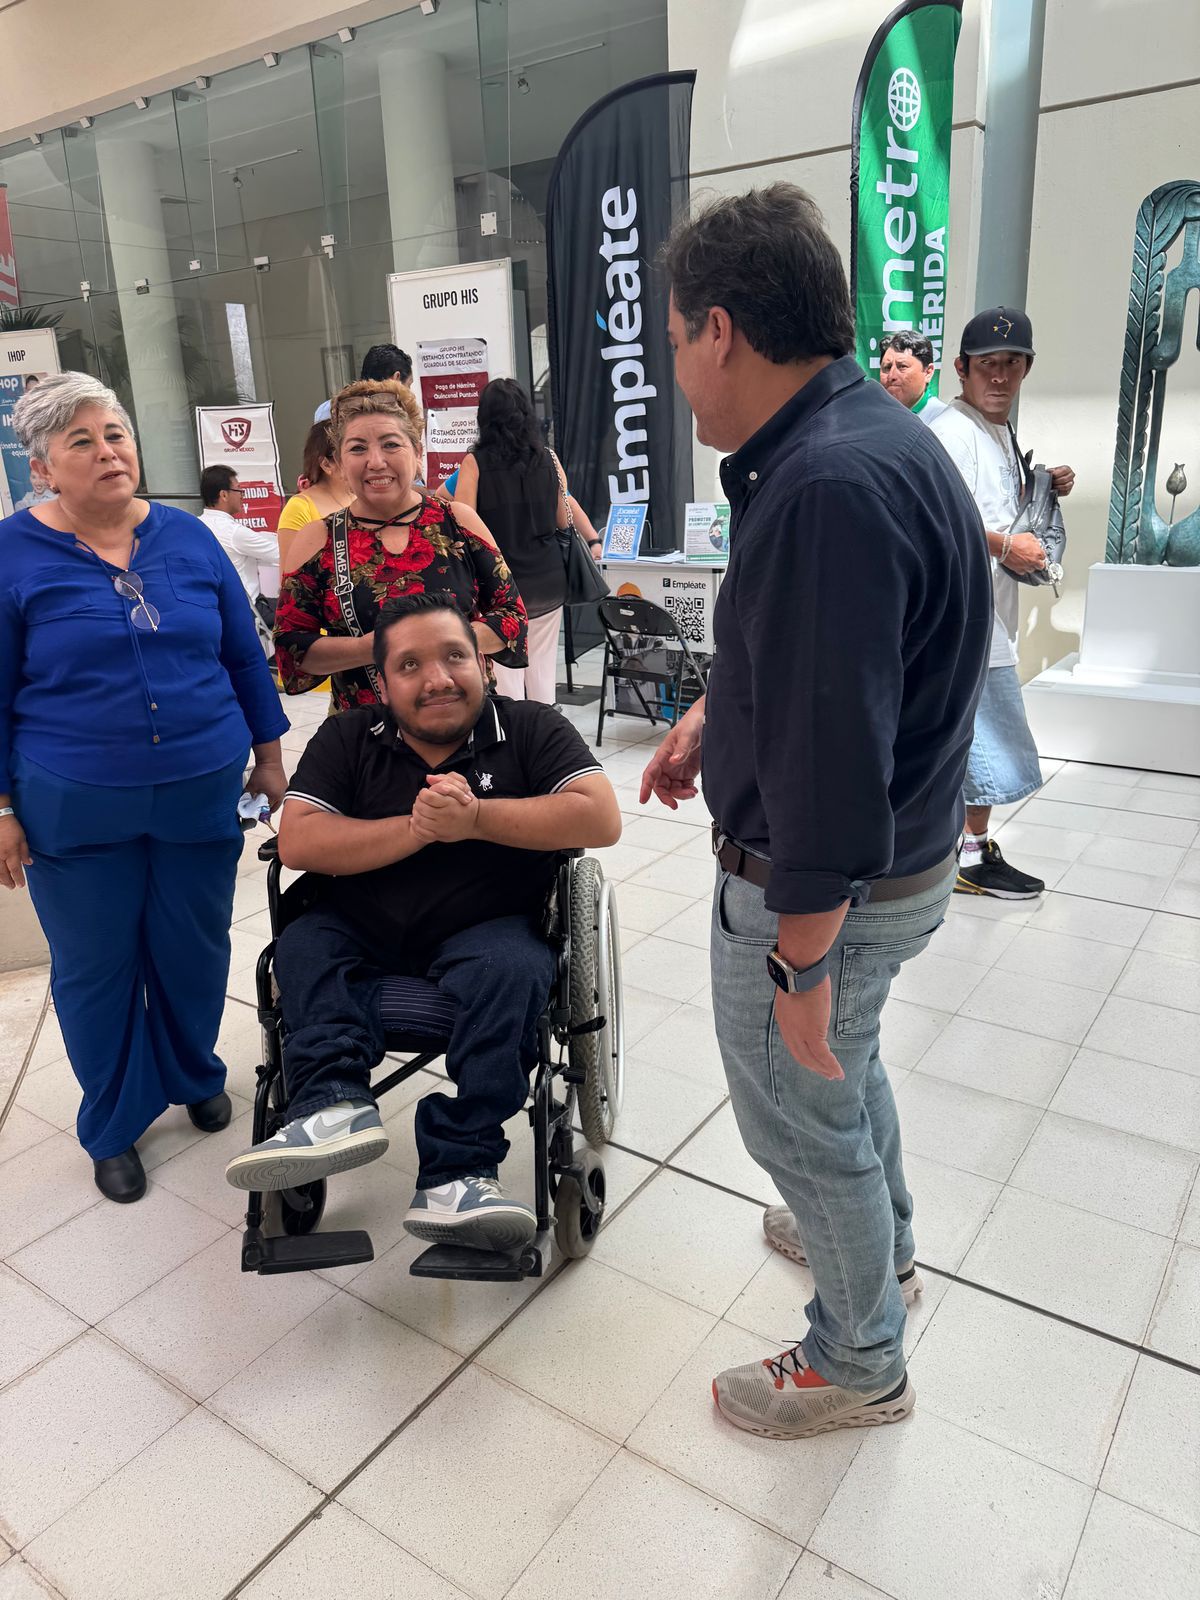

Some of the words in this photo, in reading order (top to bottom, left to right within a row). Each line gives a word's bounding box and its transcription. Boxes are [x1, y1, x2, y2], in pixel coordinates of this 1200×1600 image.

[423, 291, 457, 309] GRUPO
[461, 288, 478, 304] HIS
[7, 350, 26, 362] IHOP
[596, 185, 657, 504] Empléate
[336, 540, 348, 586] BIMBA
